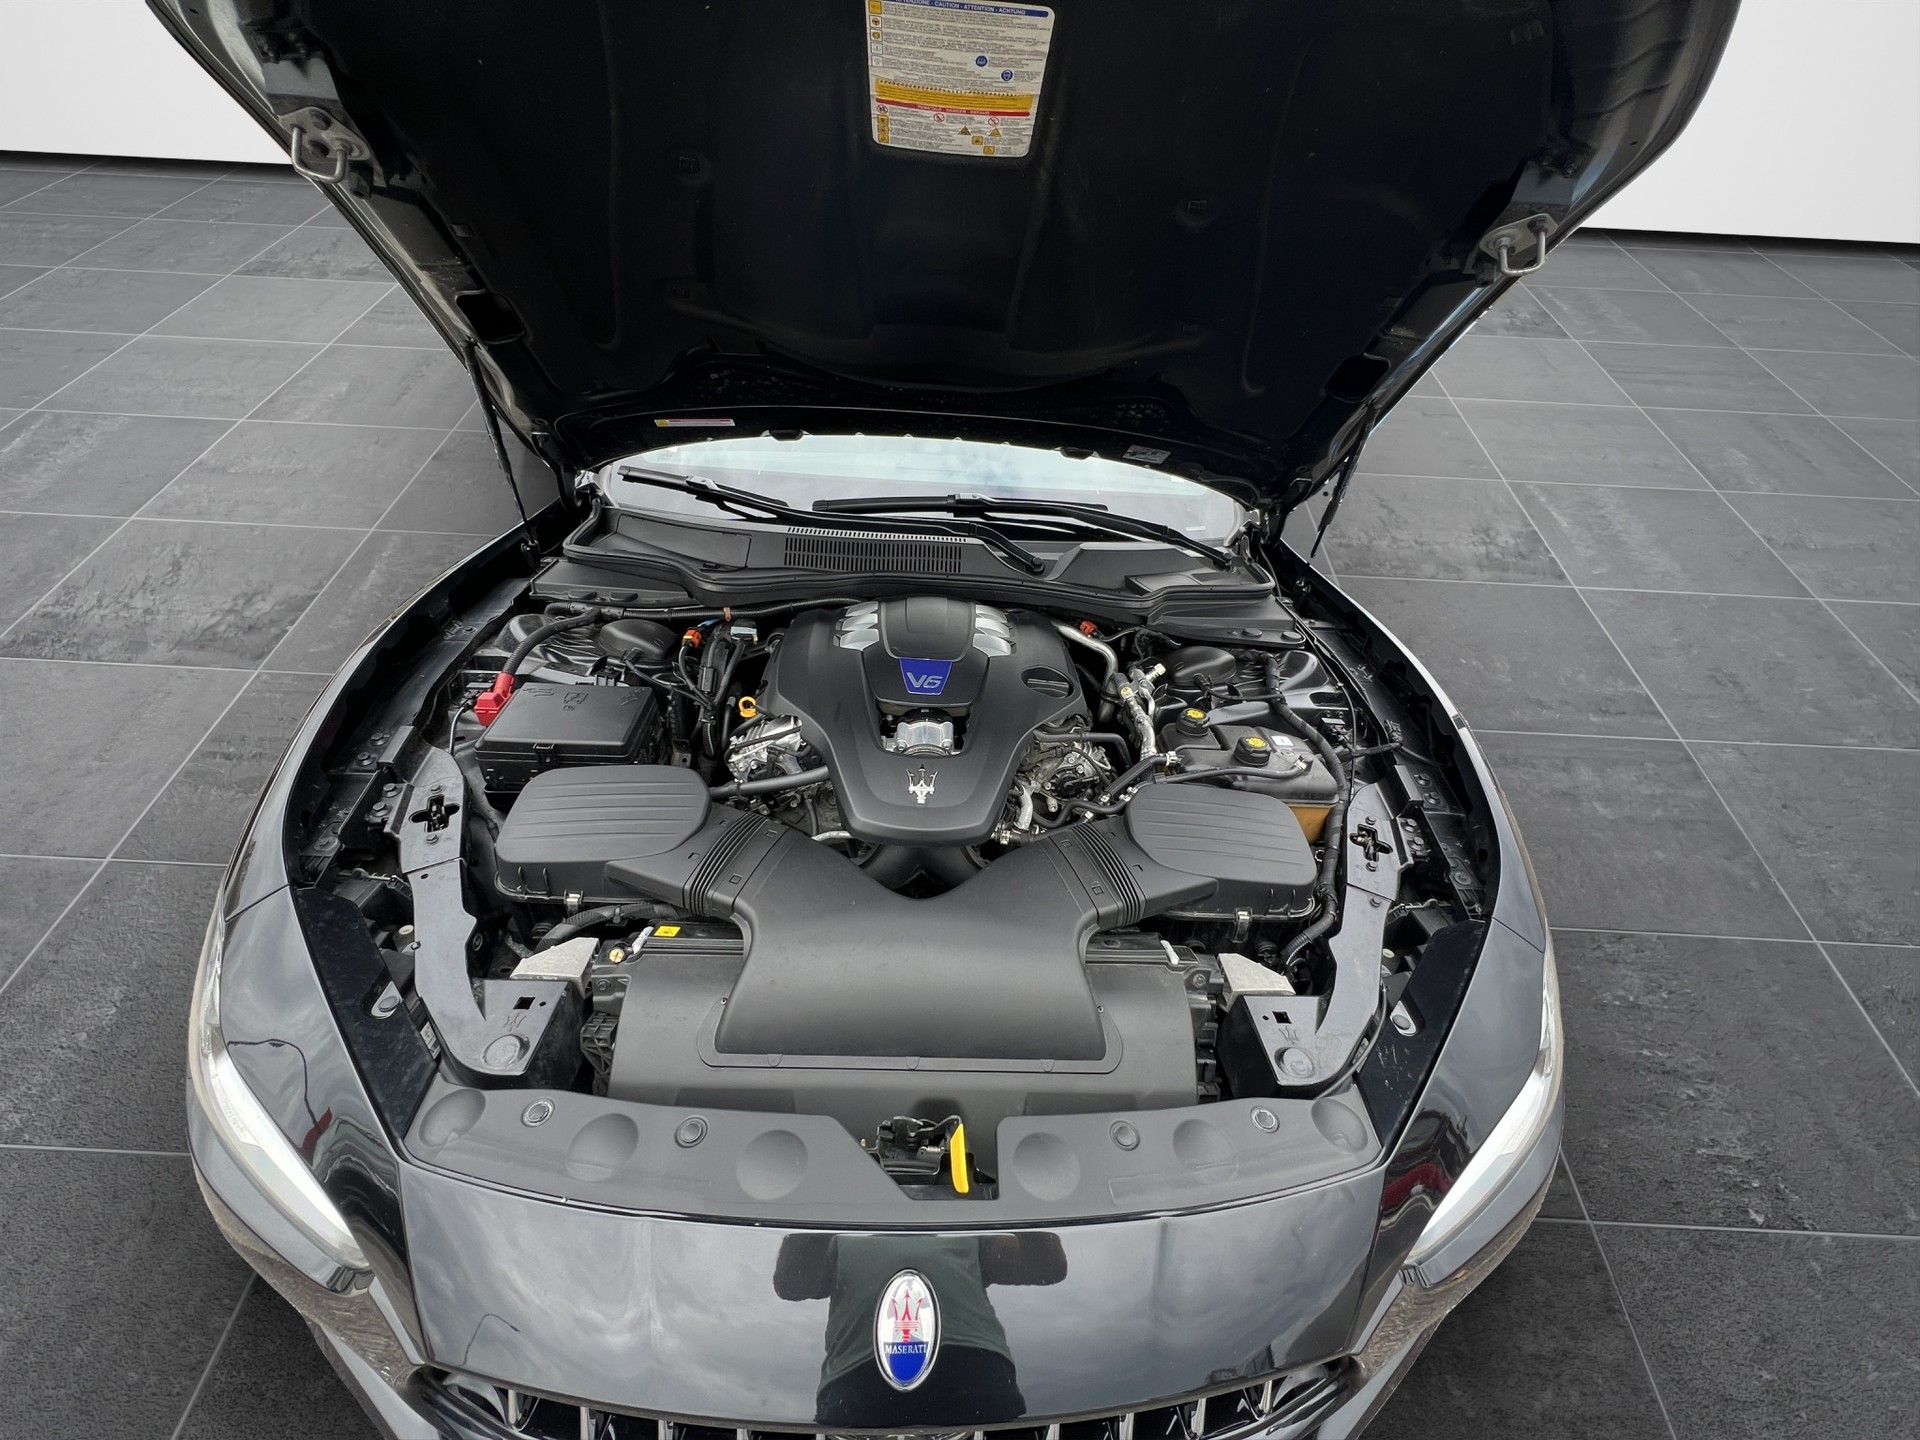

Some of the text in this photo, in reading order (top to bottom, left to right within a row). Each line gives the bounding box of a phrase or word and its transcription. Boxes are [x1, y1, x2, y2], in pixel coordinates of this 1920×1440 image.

[964, 4, 995, 12] ATTENTION
[998, 7, 1026, 15] ACHTUNG
[906, 672, 943, 688] V6
[884, 1344, 927, 1354] MASERATI
